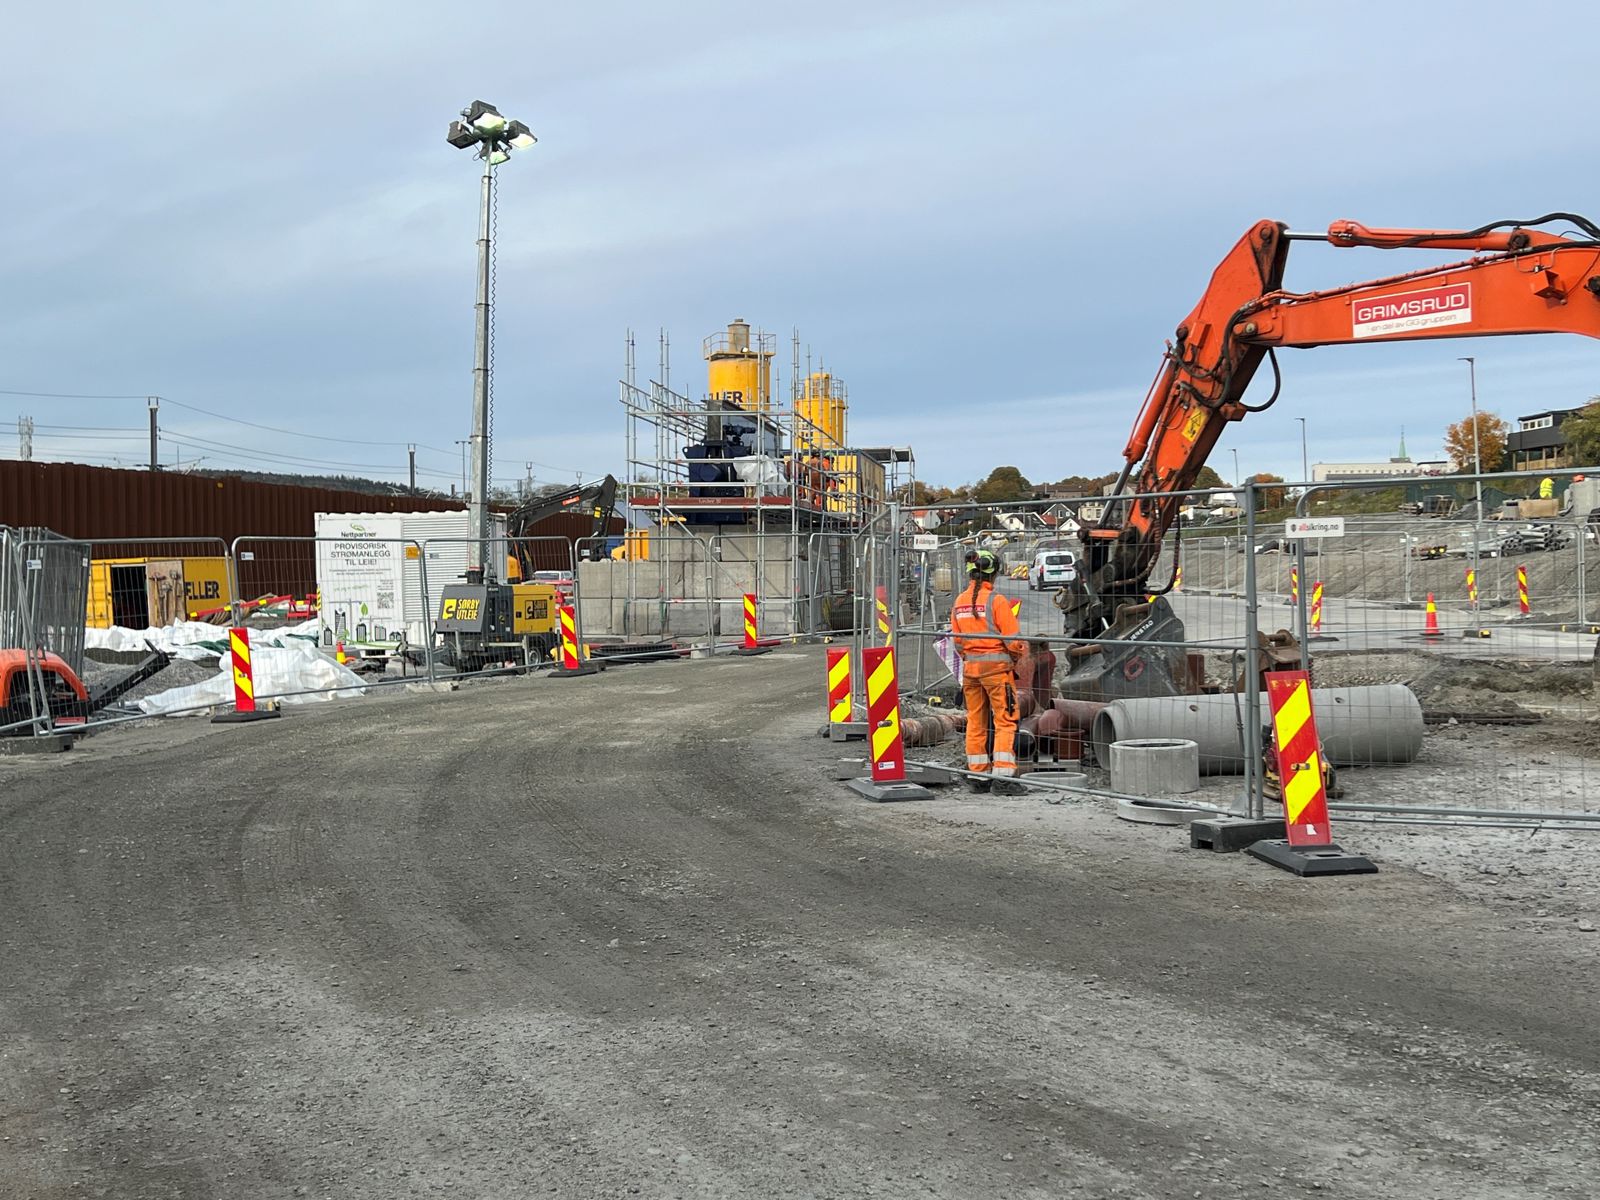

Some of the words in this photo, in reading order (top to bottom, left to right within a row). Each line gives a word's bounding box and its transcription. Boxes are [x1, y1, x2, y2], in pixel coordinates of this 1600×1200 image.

[1358, 293, 1465, 321] GRIMSRUD
[341, 531, 377, 539] Nettpartner
[334, 542, 387, 550] PROVISORISK
[330, 550, 391, 558] STRØMANLEGG
[345, 558, 356, 566] TIL
[358, 558, 377, 566] LEIE!
[184, 581, 220, 600] ELLER
[457, 599, 480, 610] SØRBY
[456, 609, 478, 620] UTLEIE
